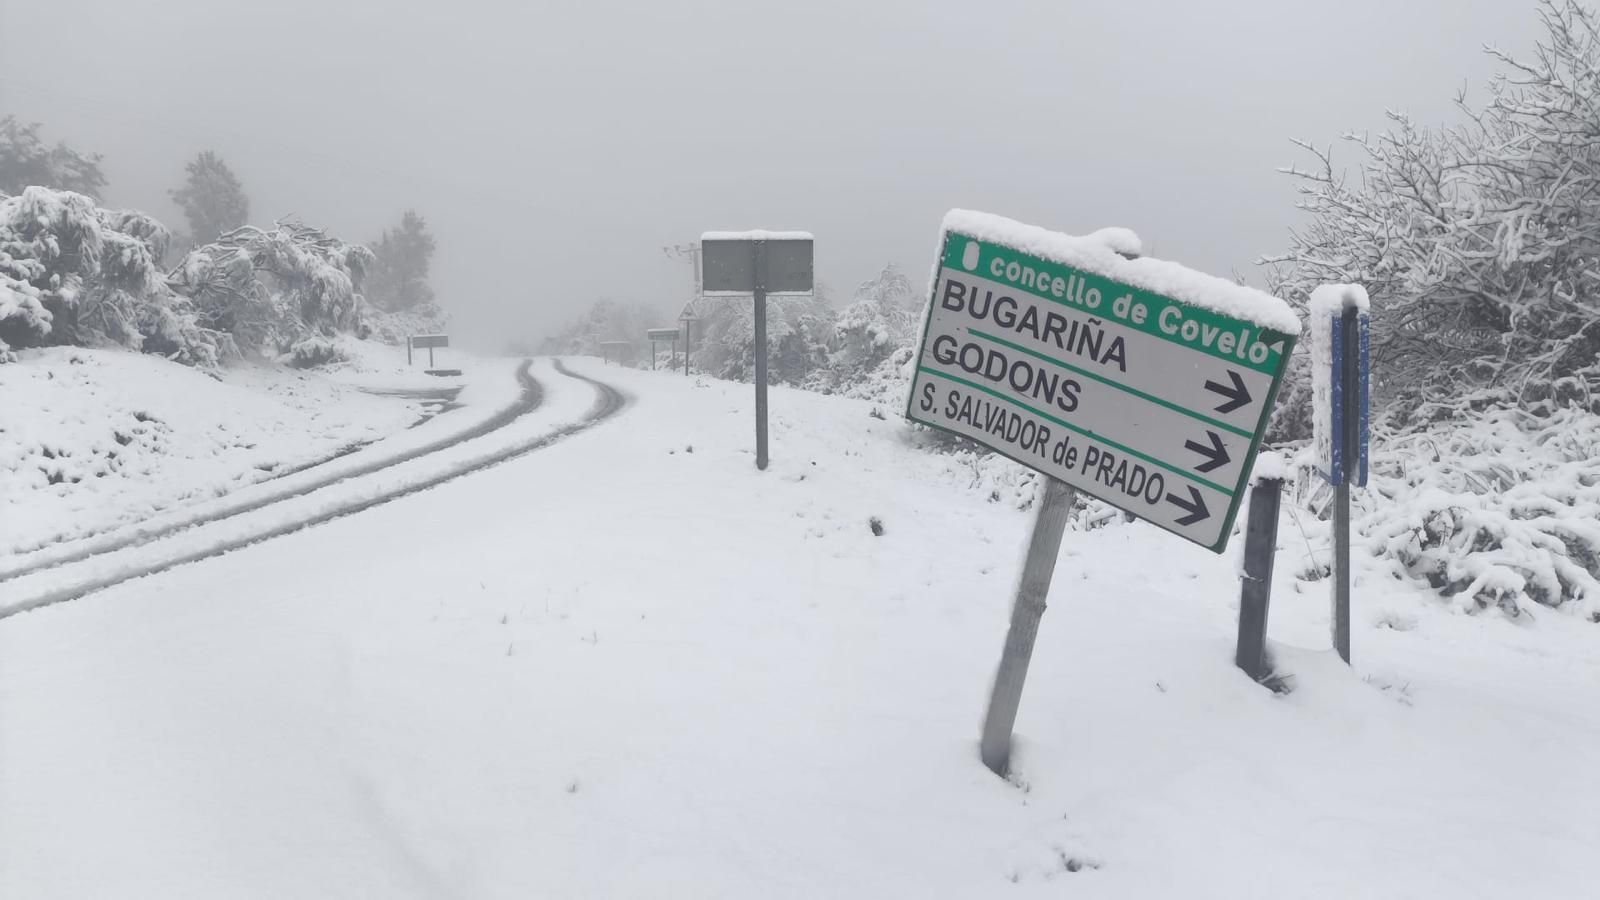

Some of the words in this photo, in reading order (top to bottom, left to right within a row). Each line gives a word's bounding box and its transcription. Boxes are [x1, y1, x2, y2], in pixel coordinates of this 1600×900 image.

[942, 279, 1127, 373] BUGARIÑA
[990, 257, 1102, 309] concello
[1112, 294, 1148, 325] de
[1158, 305, 1269, 364] Covelo
[932, 335, 1082, 412] GODONS
[920, 382, 938, 414] S.
[945, 390, 1051, 458] SALVADOR
[1052, 436, 1078, 470] de
[1081, 445, 1165, 505] PRADO
